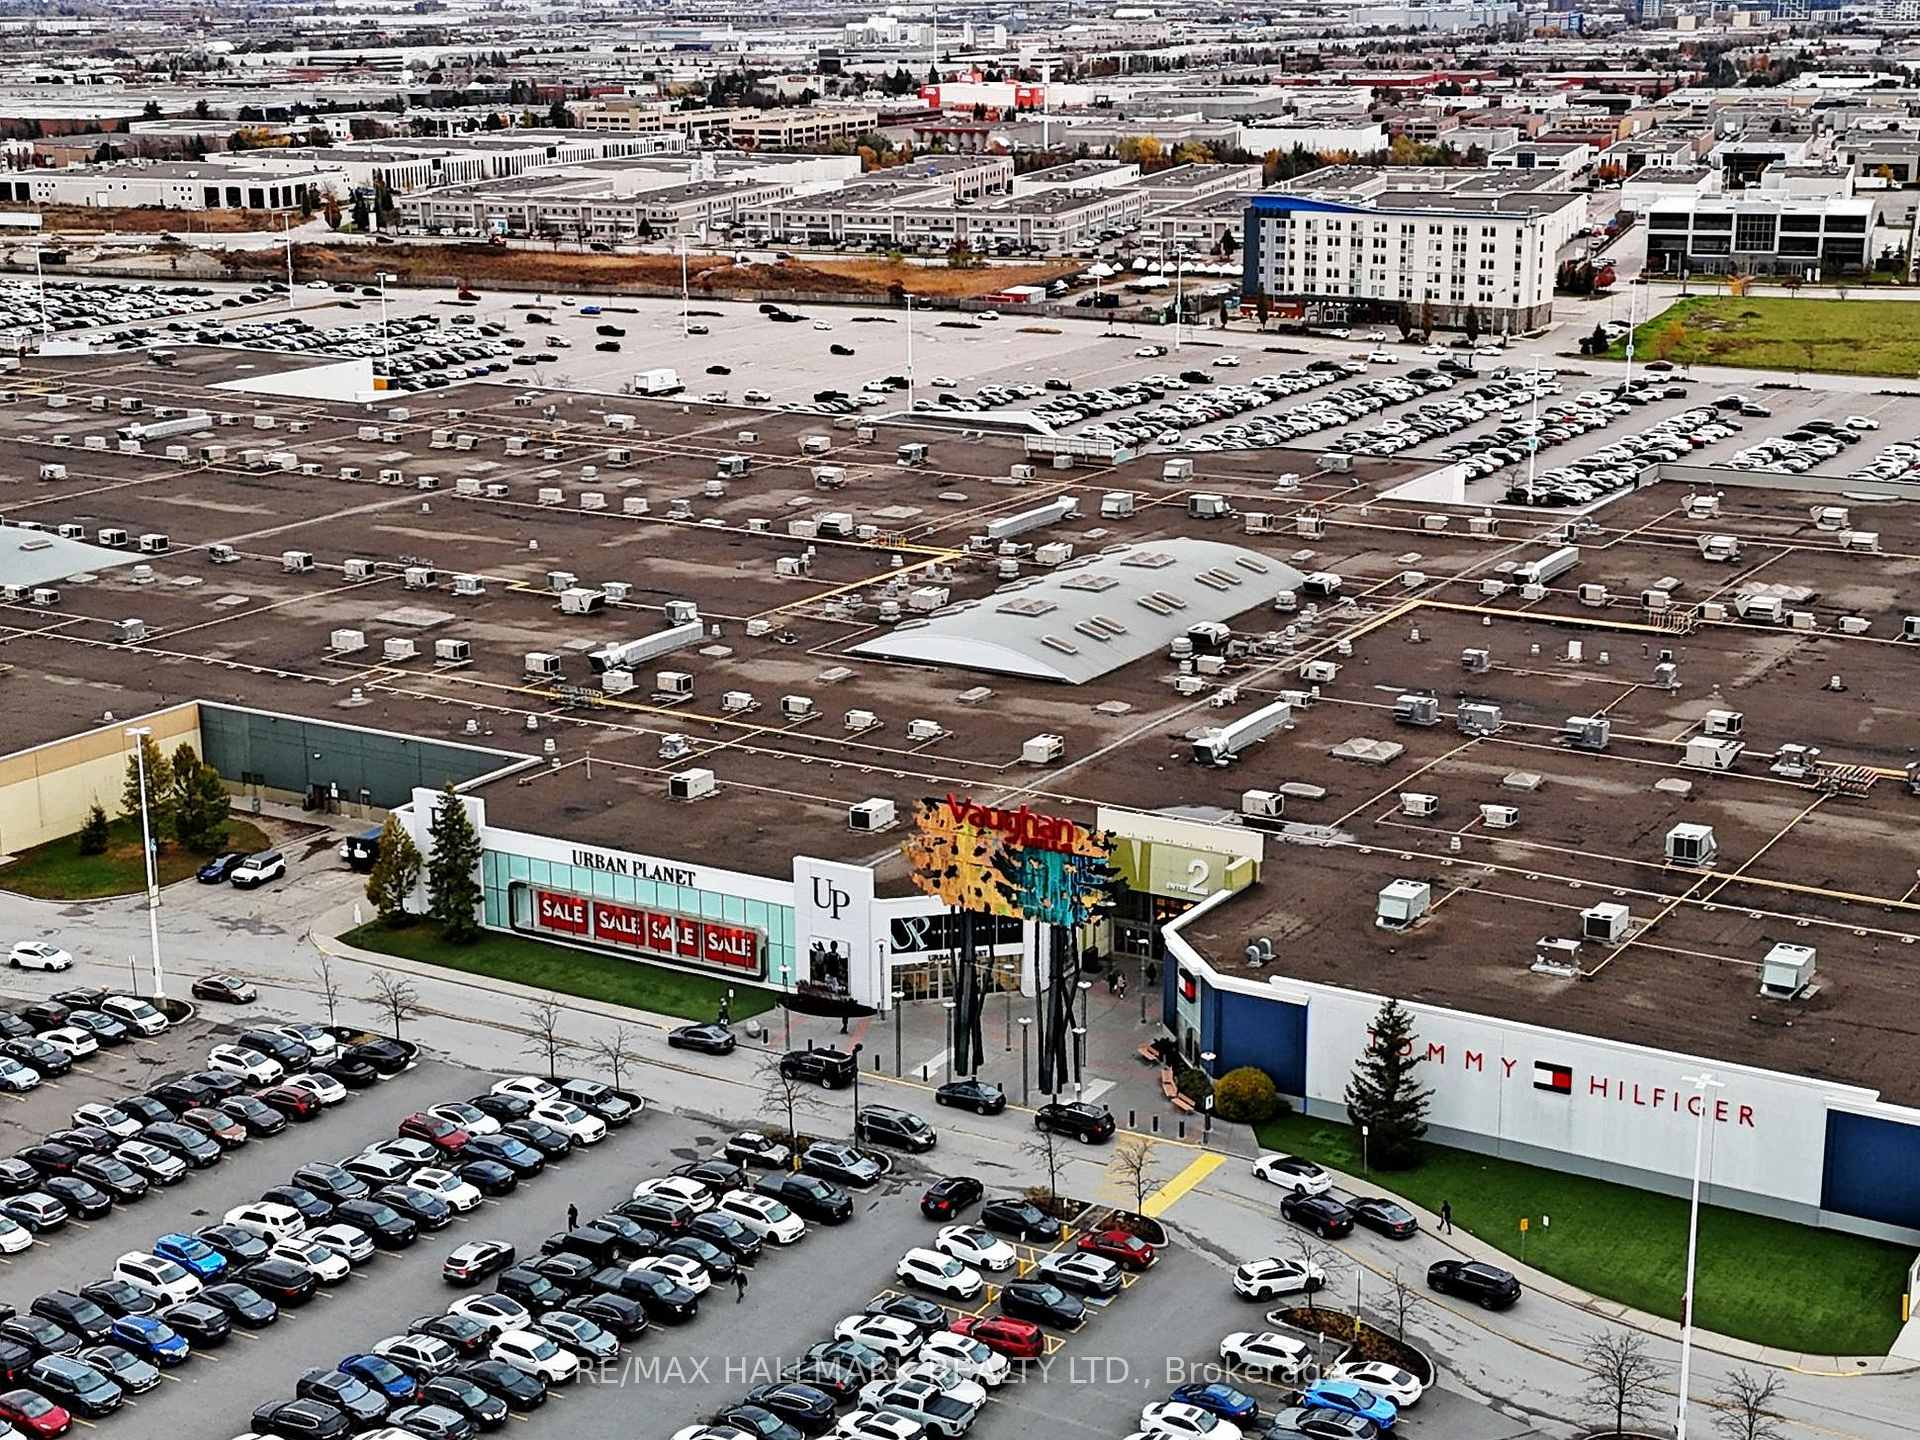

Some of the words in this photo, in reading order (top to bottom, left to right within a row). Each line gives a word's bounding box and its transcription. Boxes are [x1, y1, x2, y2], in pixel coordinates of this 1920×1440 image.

[946, 794, 1072, 842] Vaughan
[572, 849, 627, 874] URBAN
[633, 860, 696, 887] PLANET
[1187, 858, 1209, 896] 2
[543, 900, 583, 923] SALE
[810, 876, 850, 920] UP
[600, 911, 641, 935] SALE
[652, 920, 694, 946] SALE
[891, 916, 930, 950] UP
[708, 932, 751, 957] SALE
[1590, 1075, 1755, 1127] HILFIGER
